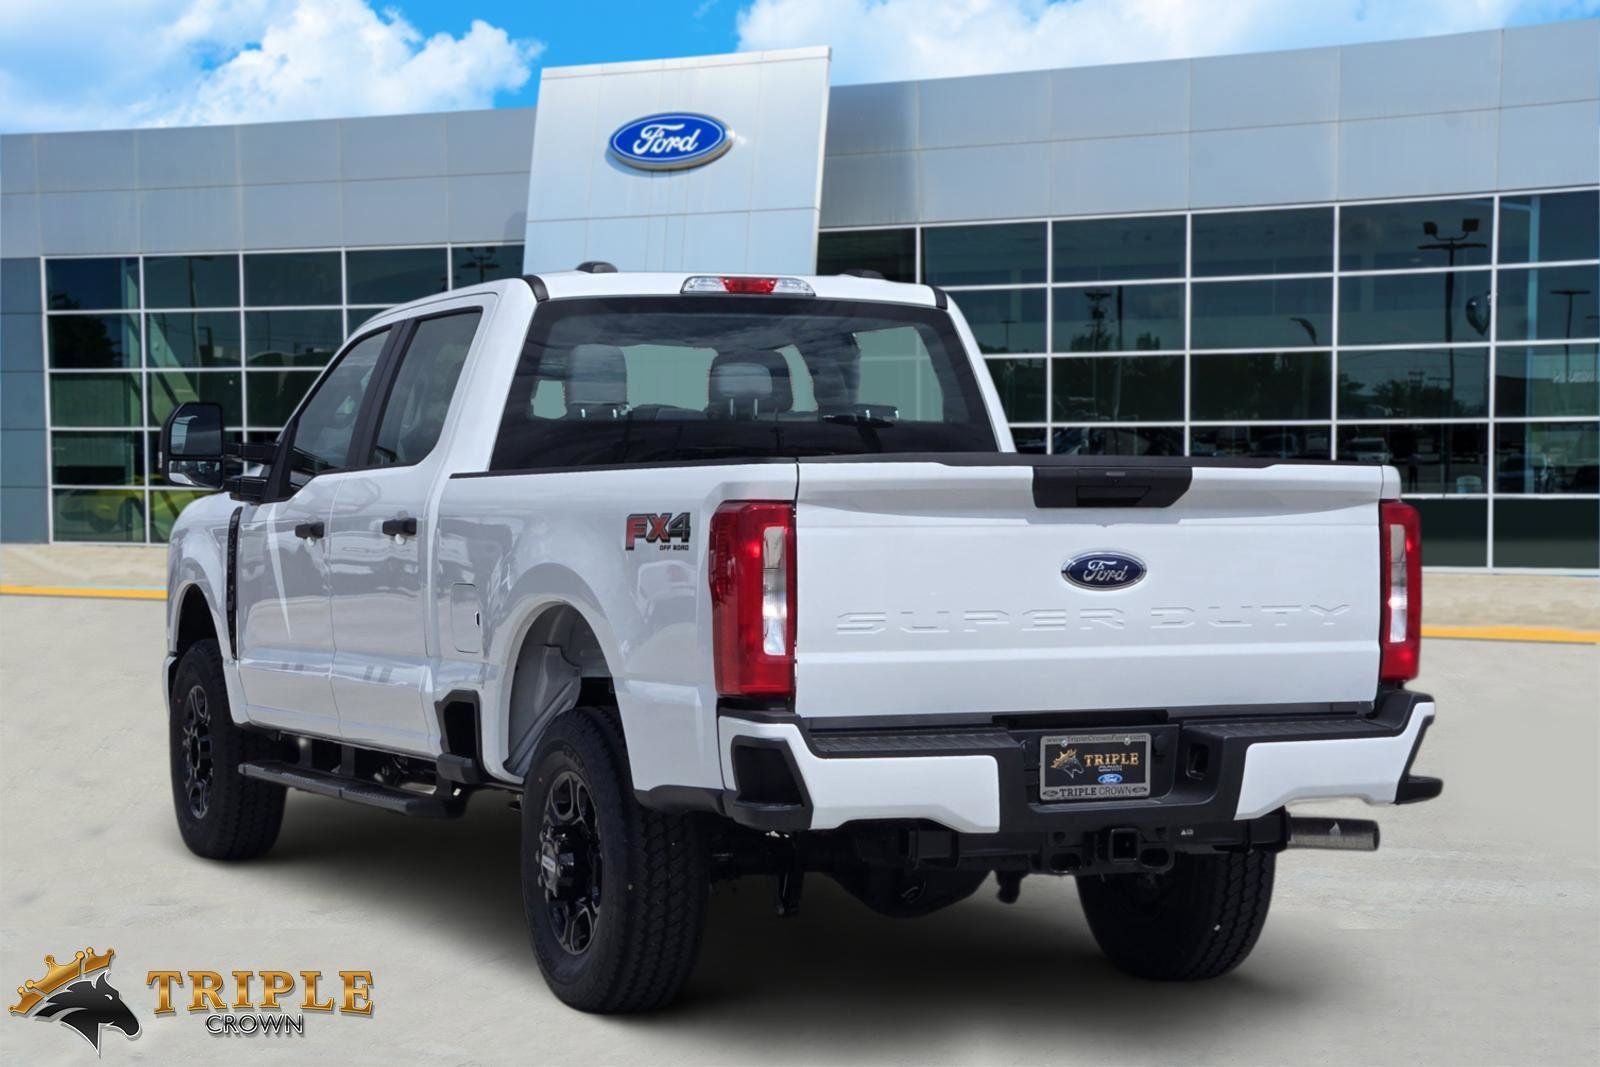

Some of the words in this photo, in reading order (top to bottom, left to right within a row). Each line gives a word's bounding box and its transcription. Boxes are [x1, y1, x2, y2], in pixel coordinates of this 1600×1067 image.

[633, 124, 702, 155] Ford
[625, 512, 691, 551] FX4
[1083, 560, 1129, 582] Ford
[836, 608, 1126, 634] SUPER
[1151, 603, 1349, 629] DUTY
[1084, 753, 1139, 766] TRIPLE
[1060, 787, 1097, 798] TRIPLE
[1100, 785, 1132, 796] CROWN
